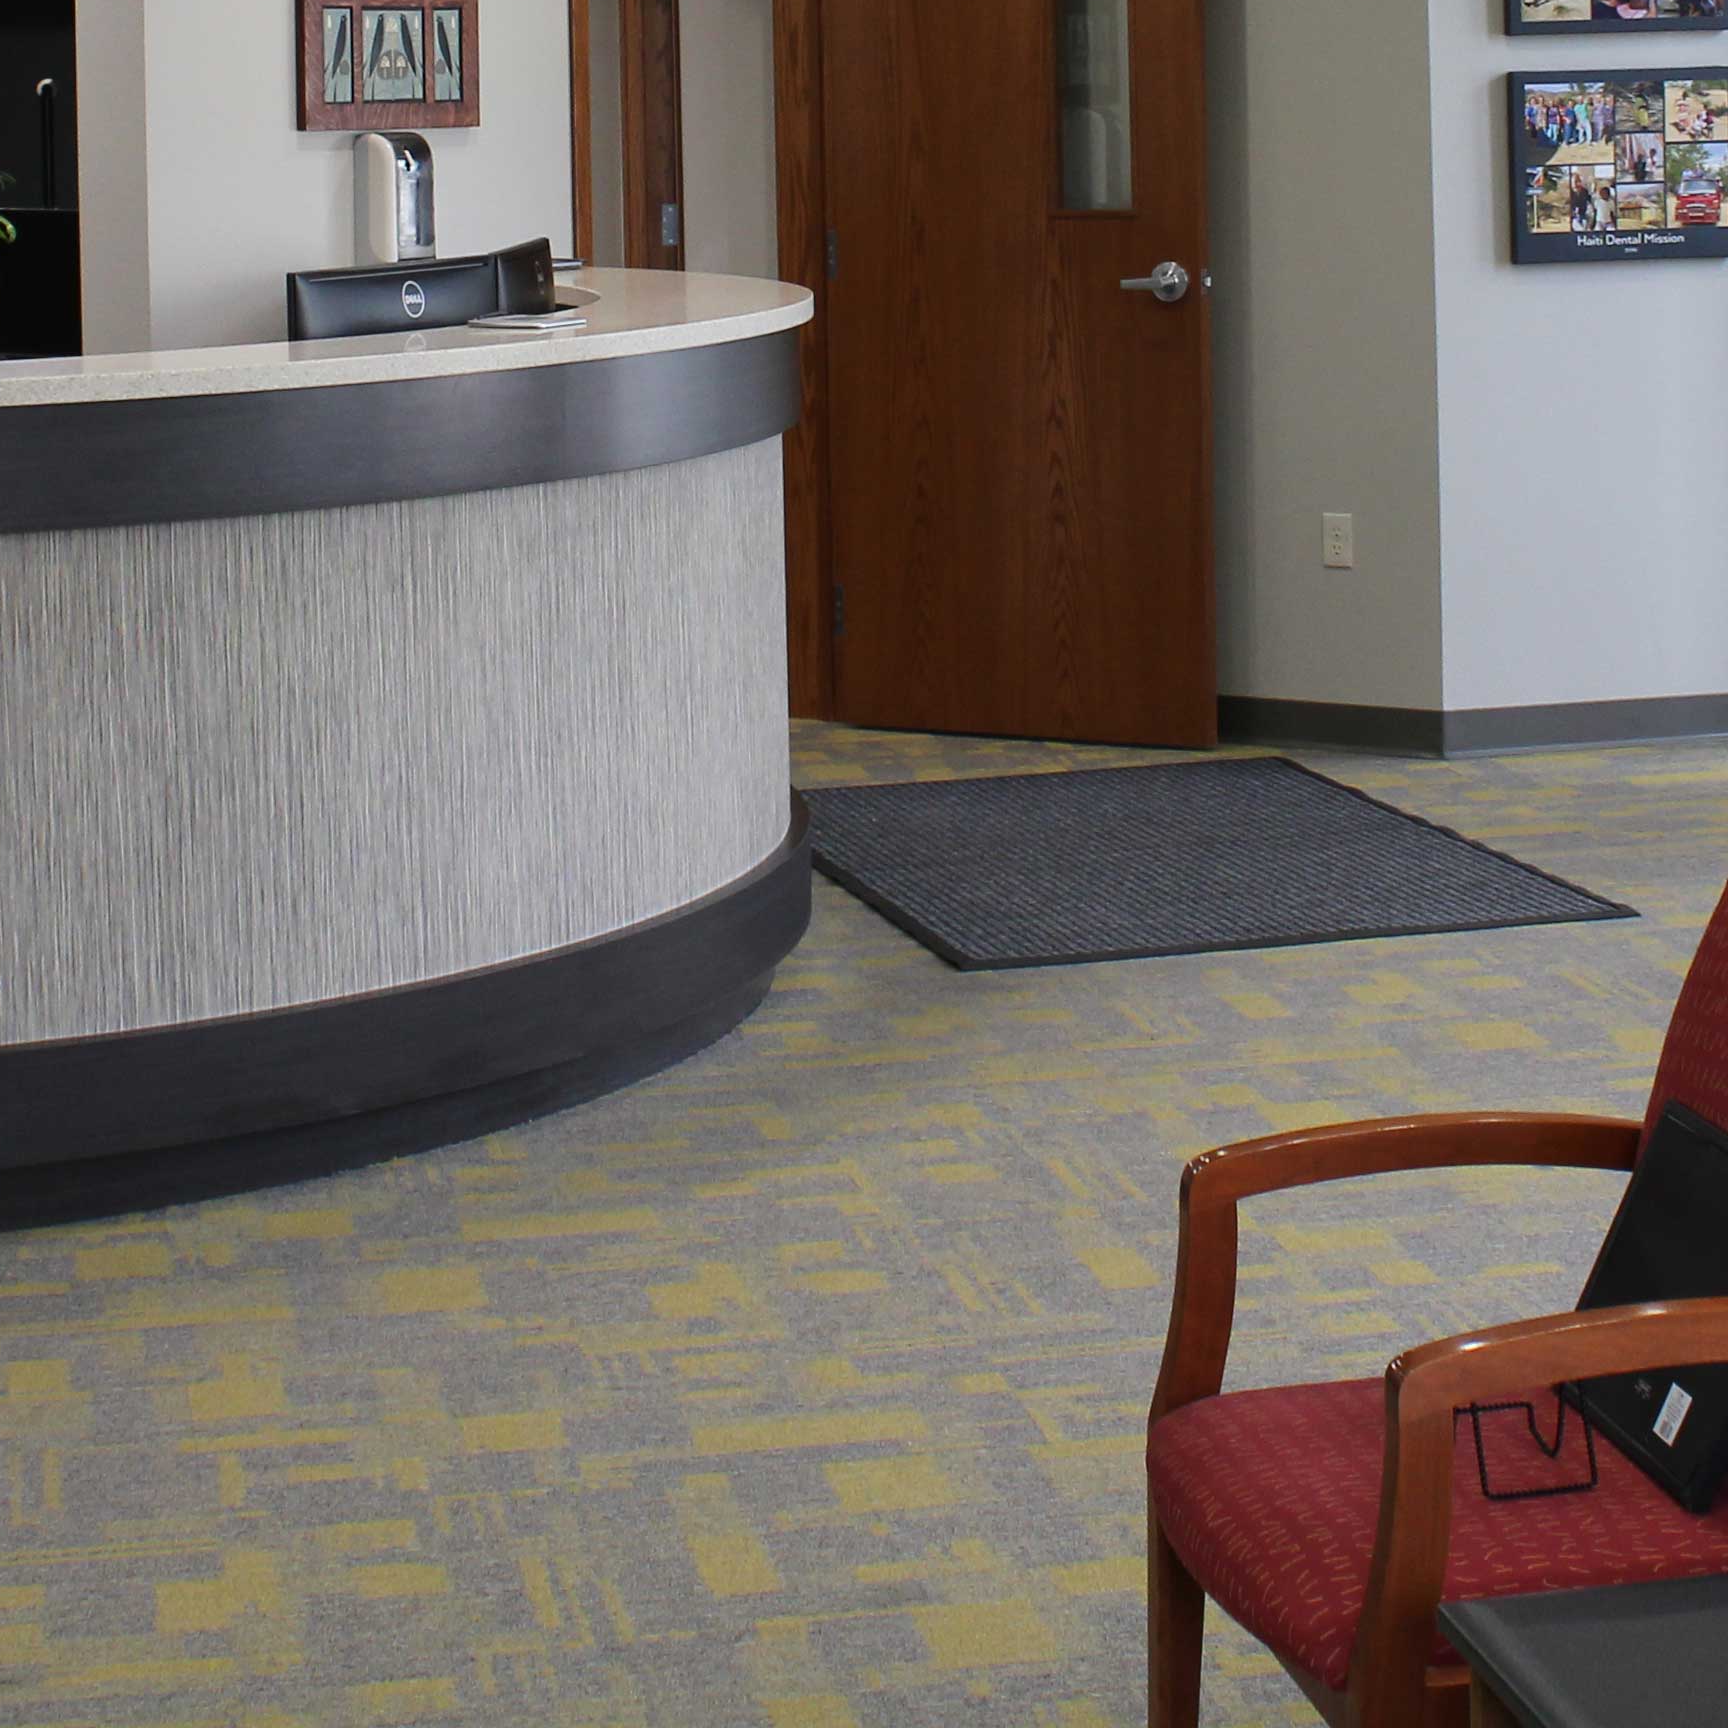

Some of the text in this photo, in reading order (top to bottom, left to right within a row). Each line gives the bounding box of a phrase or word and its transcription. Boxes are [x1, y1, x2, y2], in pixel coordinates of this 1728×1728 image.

[1577, 232, 1685, 246] Haiti Dental Mission
